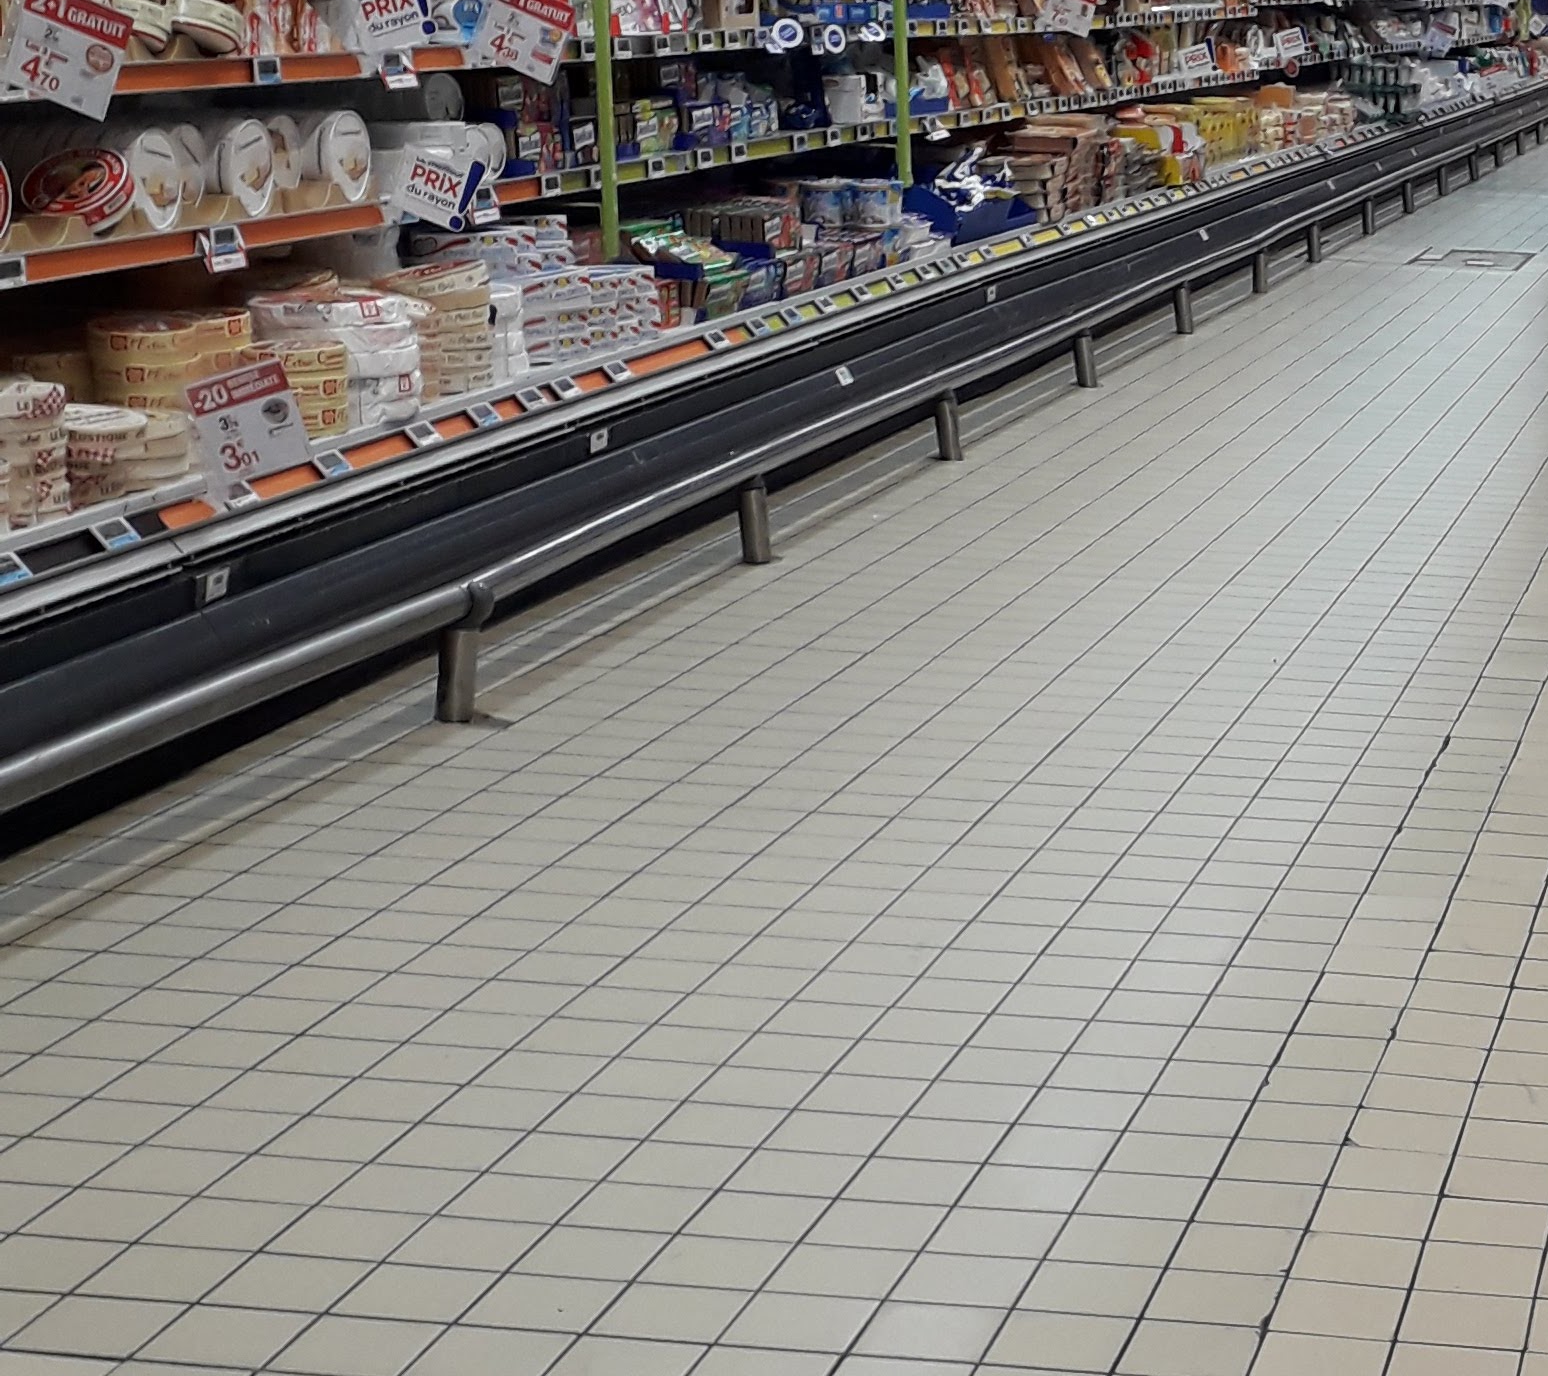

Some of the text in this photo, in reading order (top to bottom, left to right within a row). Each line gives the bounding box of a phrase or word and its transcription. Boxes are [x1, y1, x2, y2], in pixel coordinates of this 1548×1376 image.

[67, 6, 127, 39] GRATUIT
[384, 10, 419, 28] rayon
[406, 183, 456, 211] du rayon
